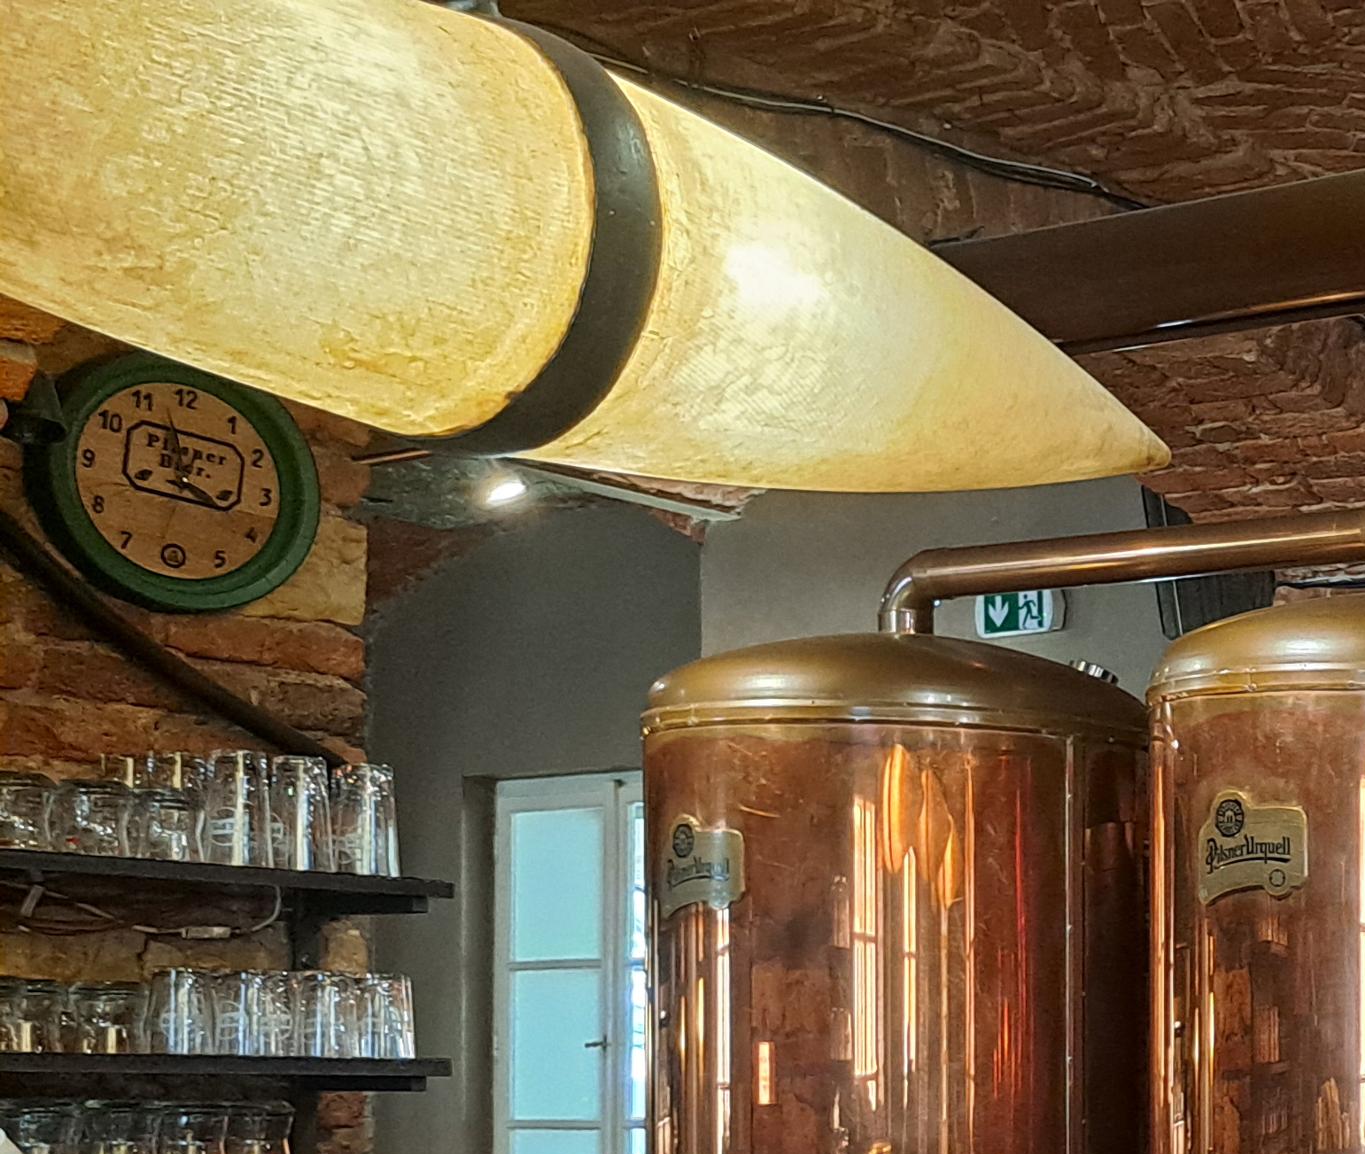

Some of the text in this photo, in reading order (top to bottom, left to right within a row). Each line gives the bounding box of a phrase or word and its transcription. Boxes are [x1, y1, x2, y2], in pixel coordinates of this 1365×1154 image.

[132, 389, 154, 412] 11
[174, 388, 198, 410] 12
[98, 410, 122, 433] 10
[227, 416, 237, 434] 1
[81, 448, 95, 468] 9
[251, 449, 264, 468] 2
[91, 496, 105, 513] 8
[259, 488, 272, 507] 3
[120, 531, 132, 549] 7
[214, 550, 227, 569] 5
[1206, 834, 1291, 874] Pilsner Urquell
